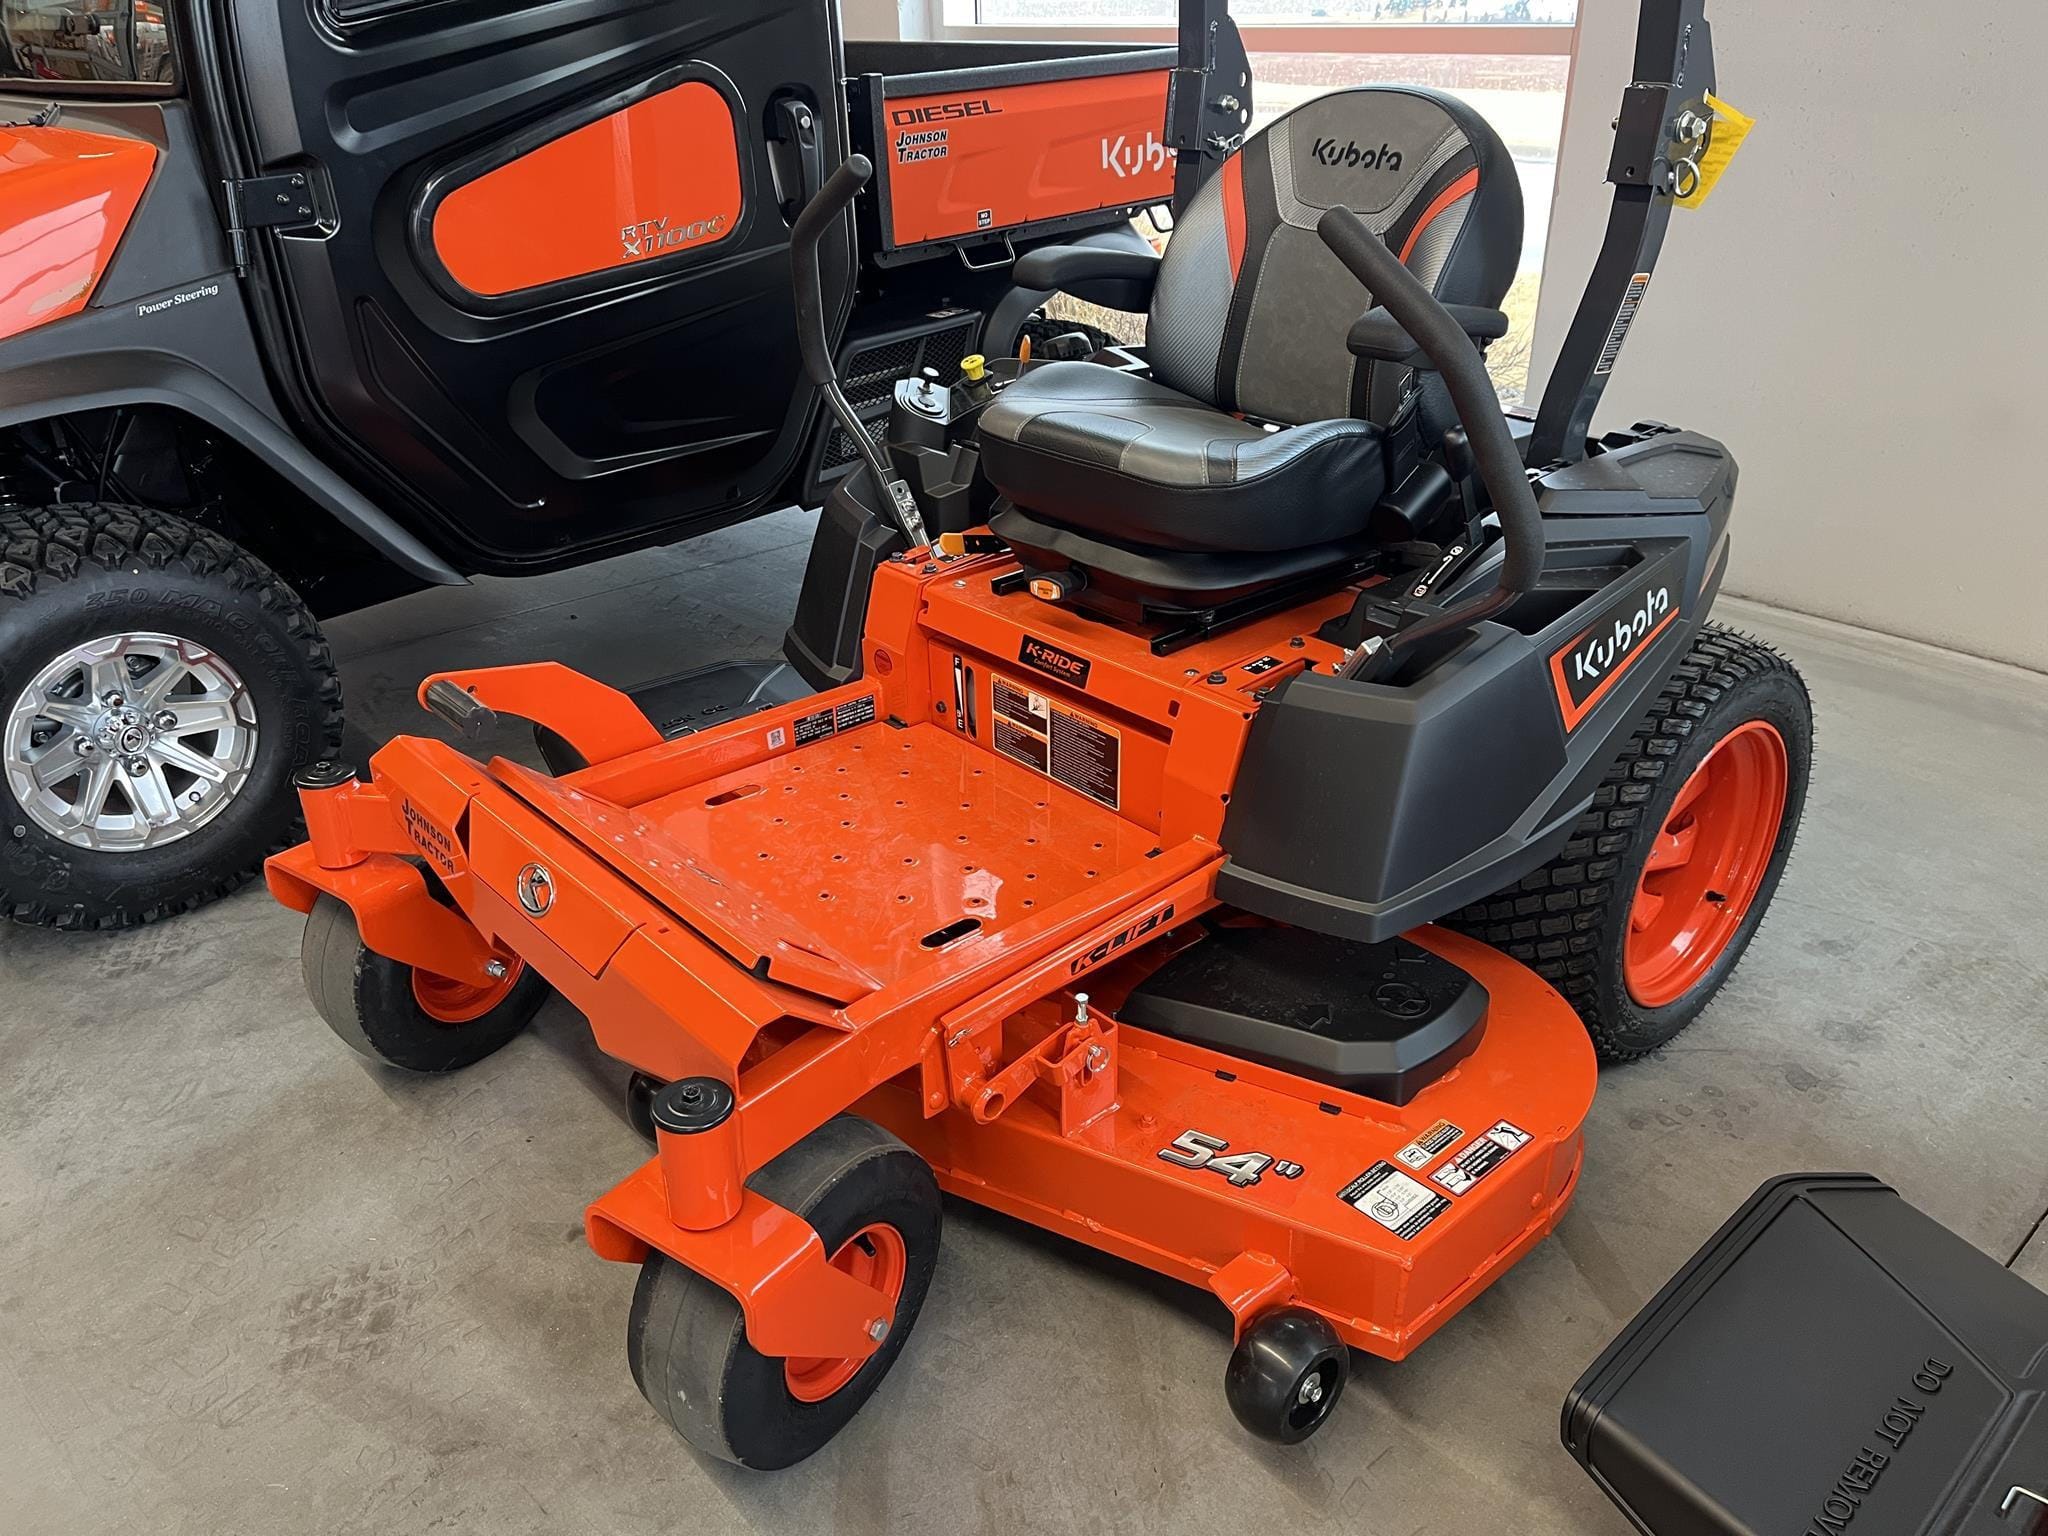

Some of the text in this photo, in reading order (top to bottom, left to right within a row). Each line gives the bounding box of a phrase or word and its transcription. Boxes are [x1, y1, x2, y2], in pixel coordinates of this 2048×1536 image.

[892, 100, 1003, 126] DIESEL
[895, 130, 948, 147] JOHNSON
[897, 146, 948, 163] TRACTOR
[1312, 138, 1403, 171] Kubota
[621, 216, 668, 240] RTV
[623, 214, 726, 259] X1100C
[138, 285, 219, 316] Power Steering
[1575, 587, 1668, 681] Kubota
[954, 656, 961, 666] F
[1026, 642, 1084, 675] K-RIDE
[957, 718, 964, 729] E
[401, 798, 451, 853] JOHNSON
[404, 815, 455, 874] TRACTOR
[1073, 905, 1172, 974] K-LIFT
[1420, 1121, 1446, 1144] WARNING
[1461, 1138, 1488, 1160] DANGER
[1912, 1357, 1953, 1393] DO
[1875, 1397, 1925, 1449] NOT
